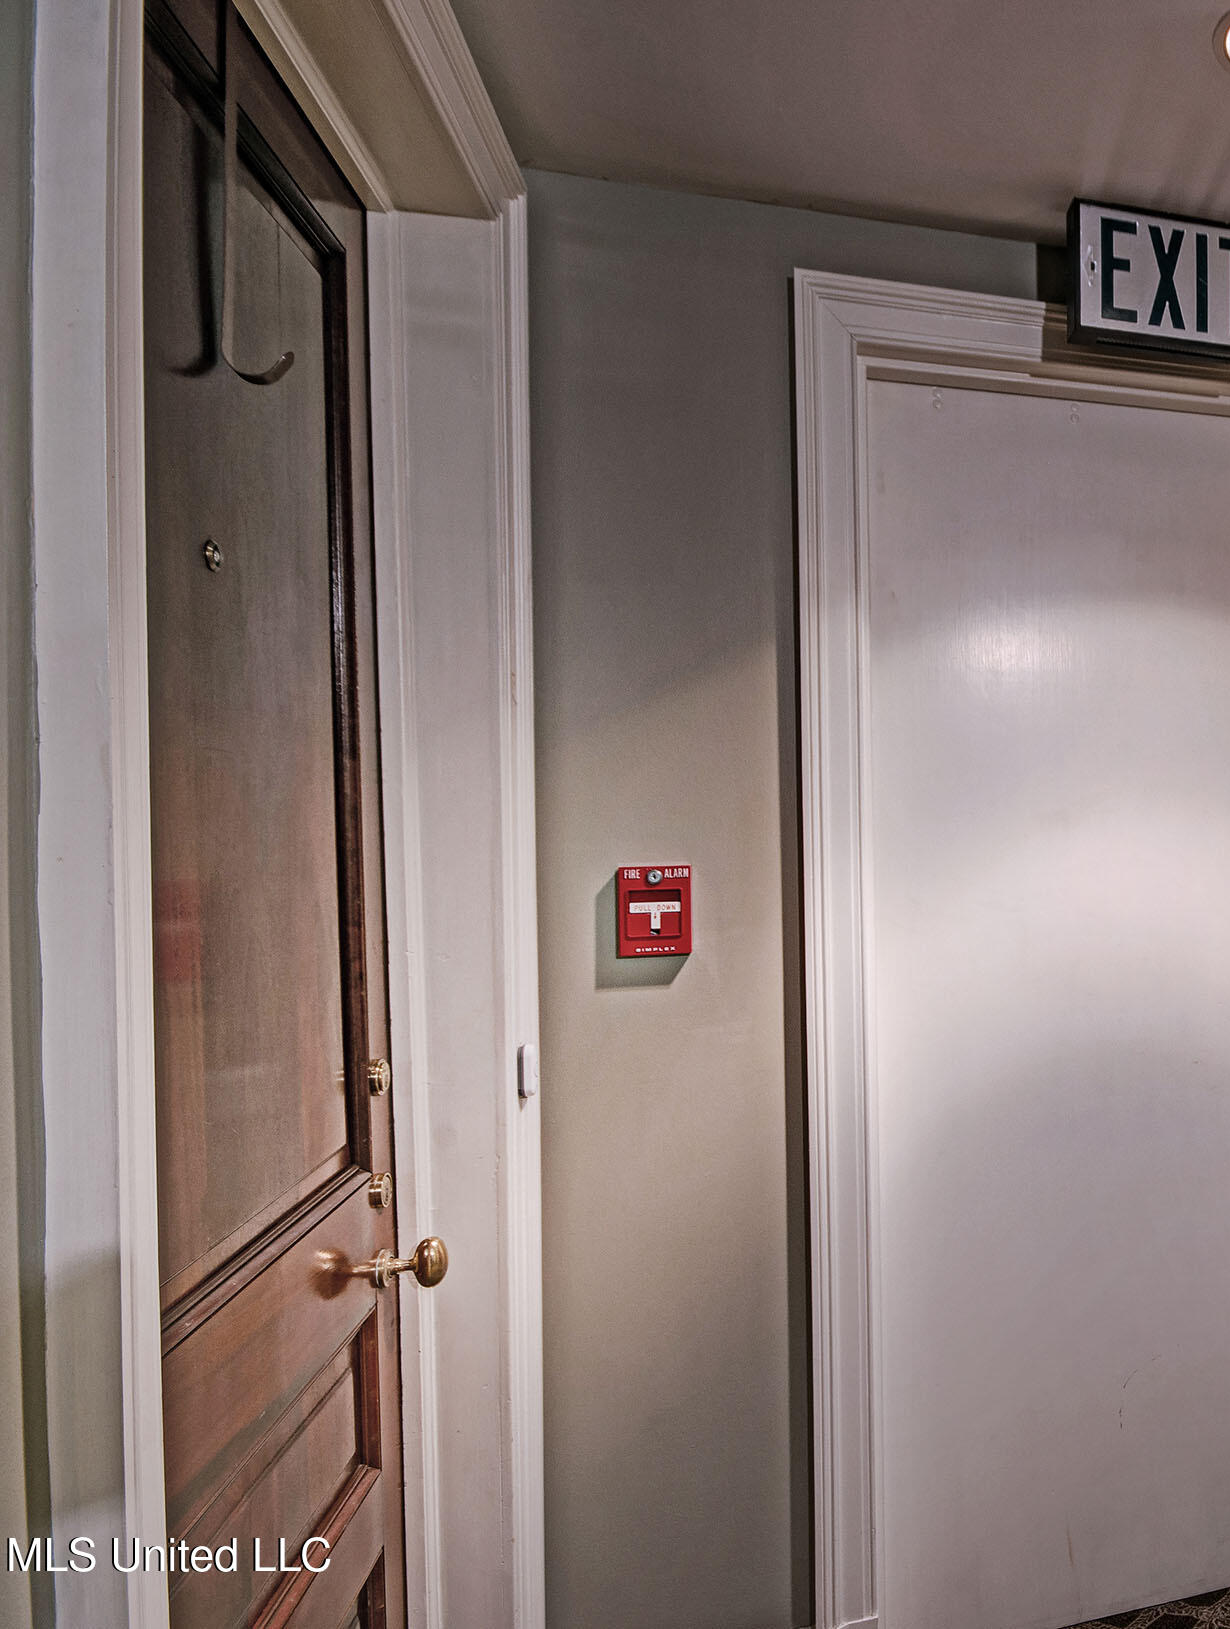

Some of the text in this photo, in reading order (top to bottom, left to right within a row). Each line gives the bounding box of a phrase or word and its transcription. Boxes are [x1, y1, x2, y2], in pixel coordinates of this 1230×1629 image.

[624, 868, 689, 879] FIRE ALARM
[656, 903, 677, 911] DOWN
